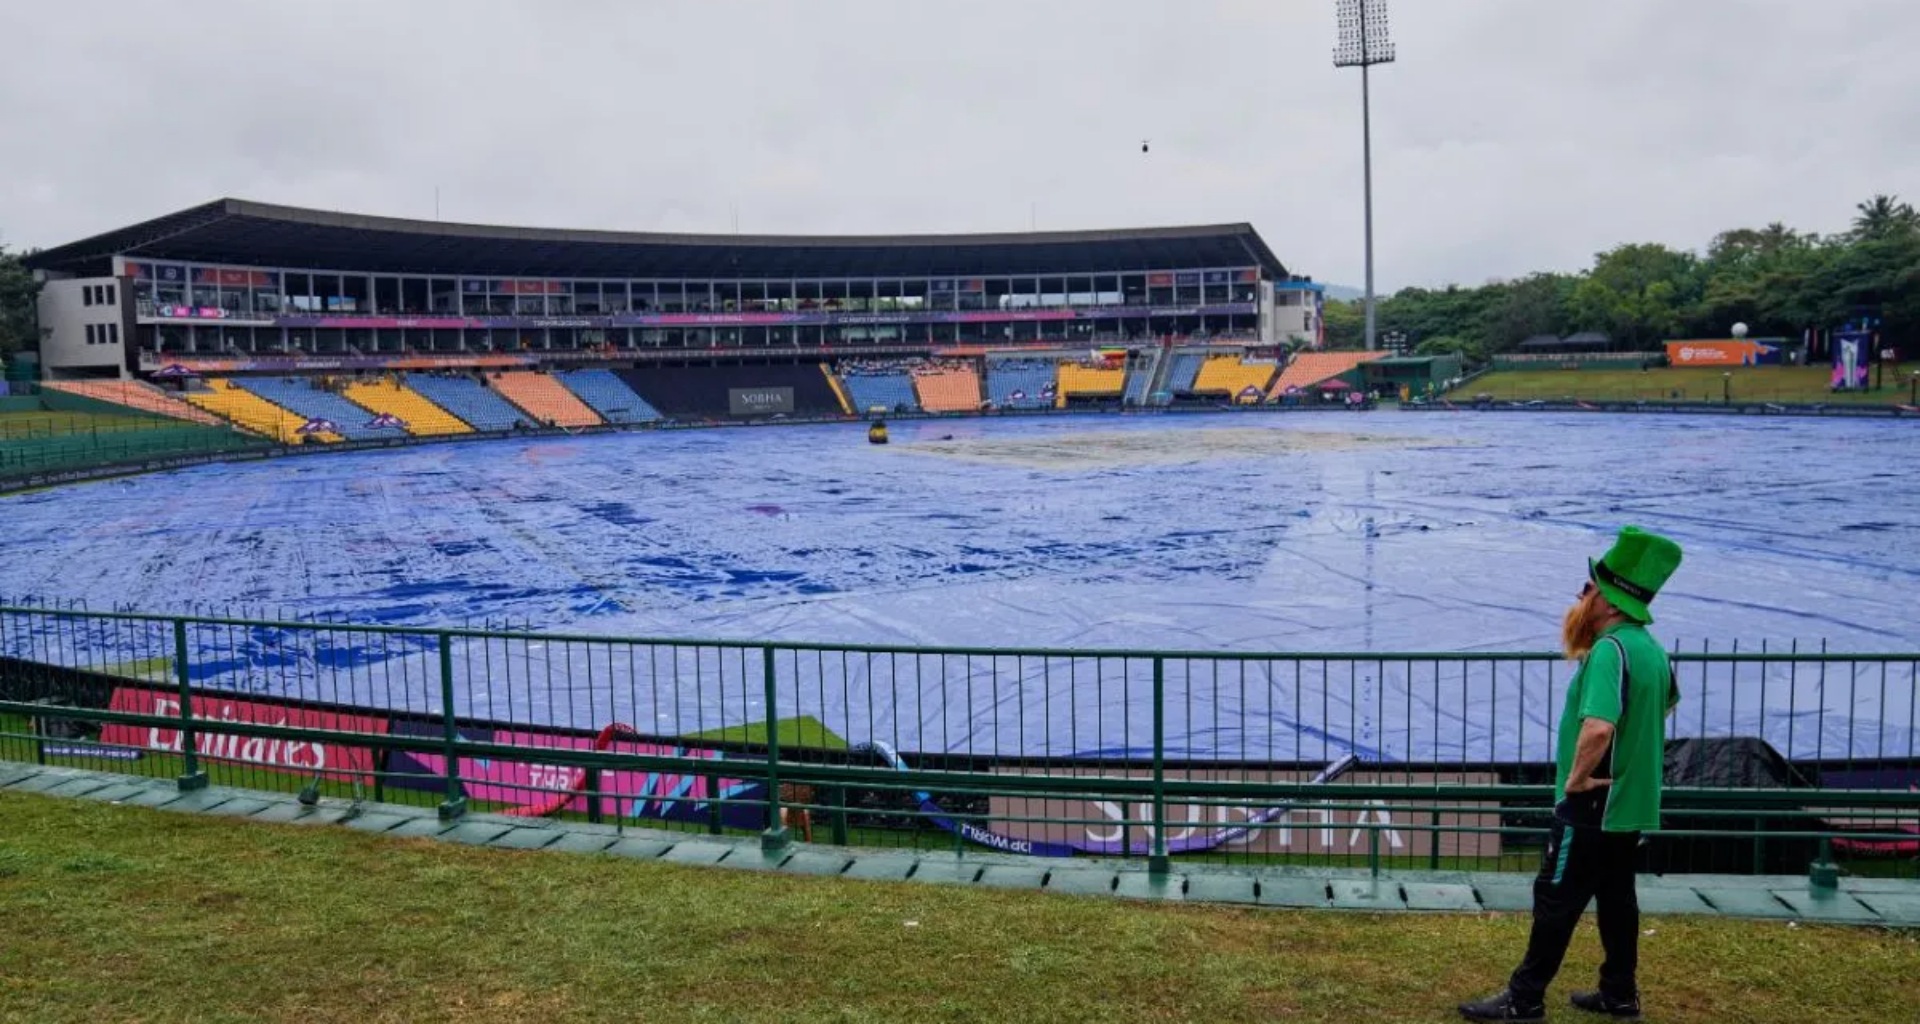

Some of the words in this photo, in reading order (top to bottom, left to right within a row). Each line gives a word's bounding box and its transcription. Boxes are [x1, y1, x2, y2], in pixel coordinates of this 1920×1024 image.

[741, 393, 782, 404] SOBHA
[149, 698, 325, 770] Emirates
[1085, 781, 1404, 847] SOBHA
